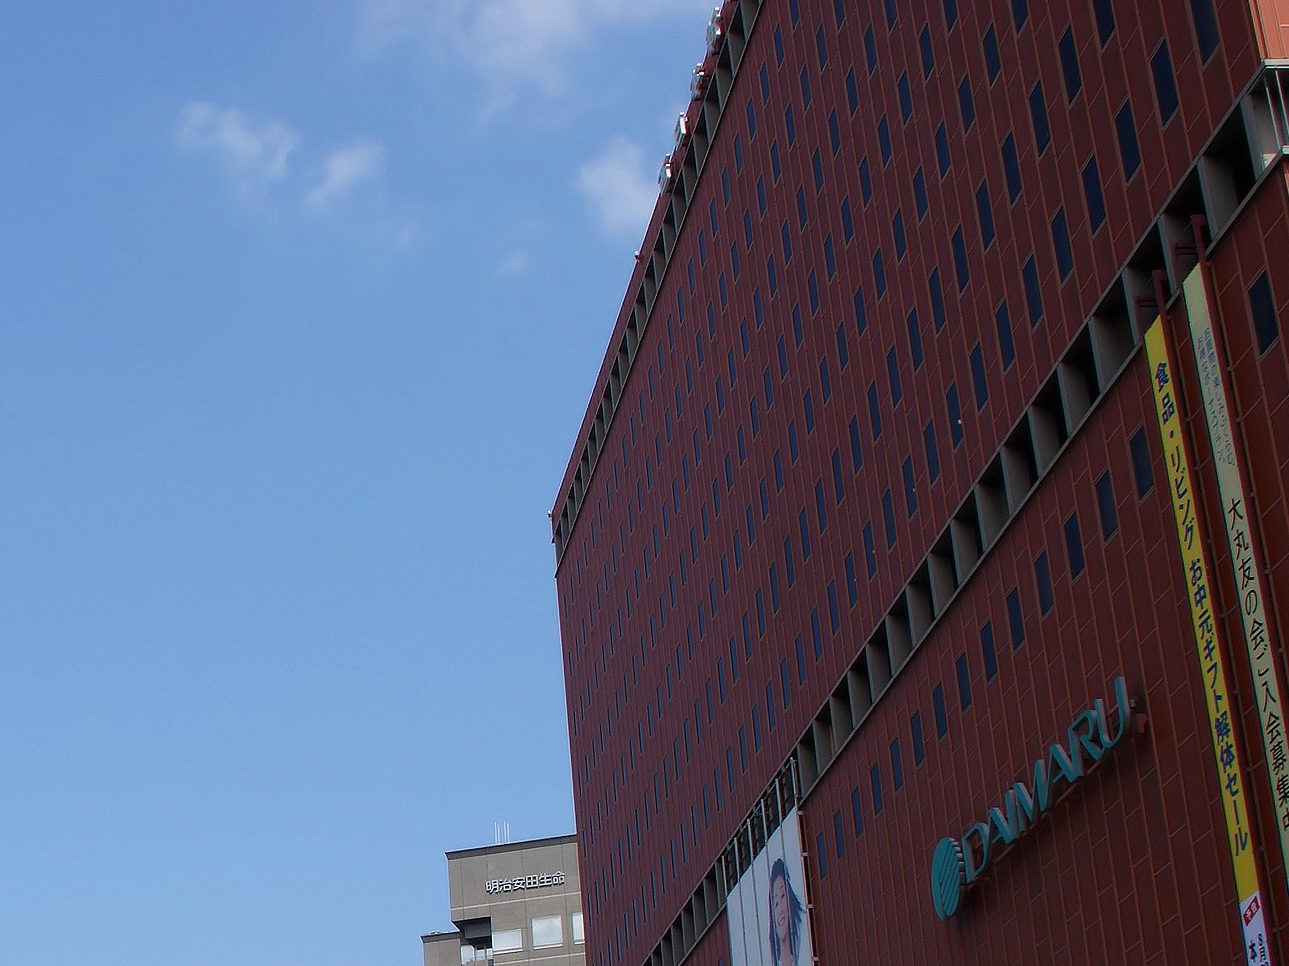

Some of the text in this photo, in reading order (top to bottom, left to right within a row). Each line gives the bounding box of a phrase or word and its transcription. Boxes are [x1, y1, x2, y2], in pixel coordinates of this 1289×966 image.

[959, 675, 1131, 884] DAIMARU
[485, 870, 566, 895] 明治安田生命
